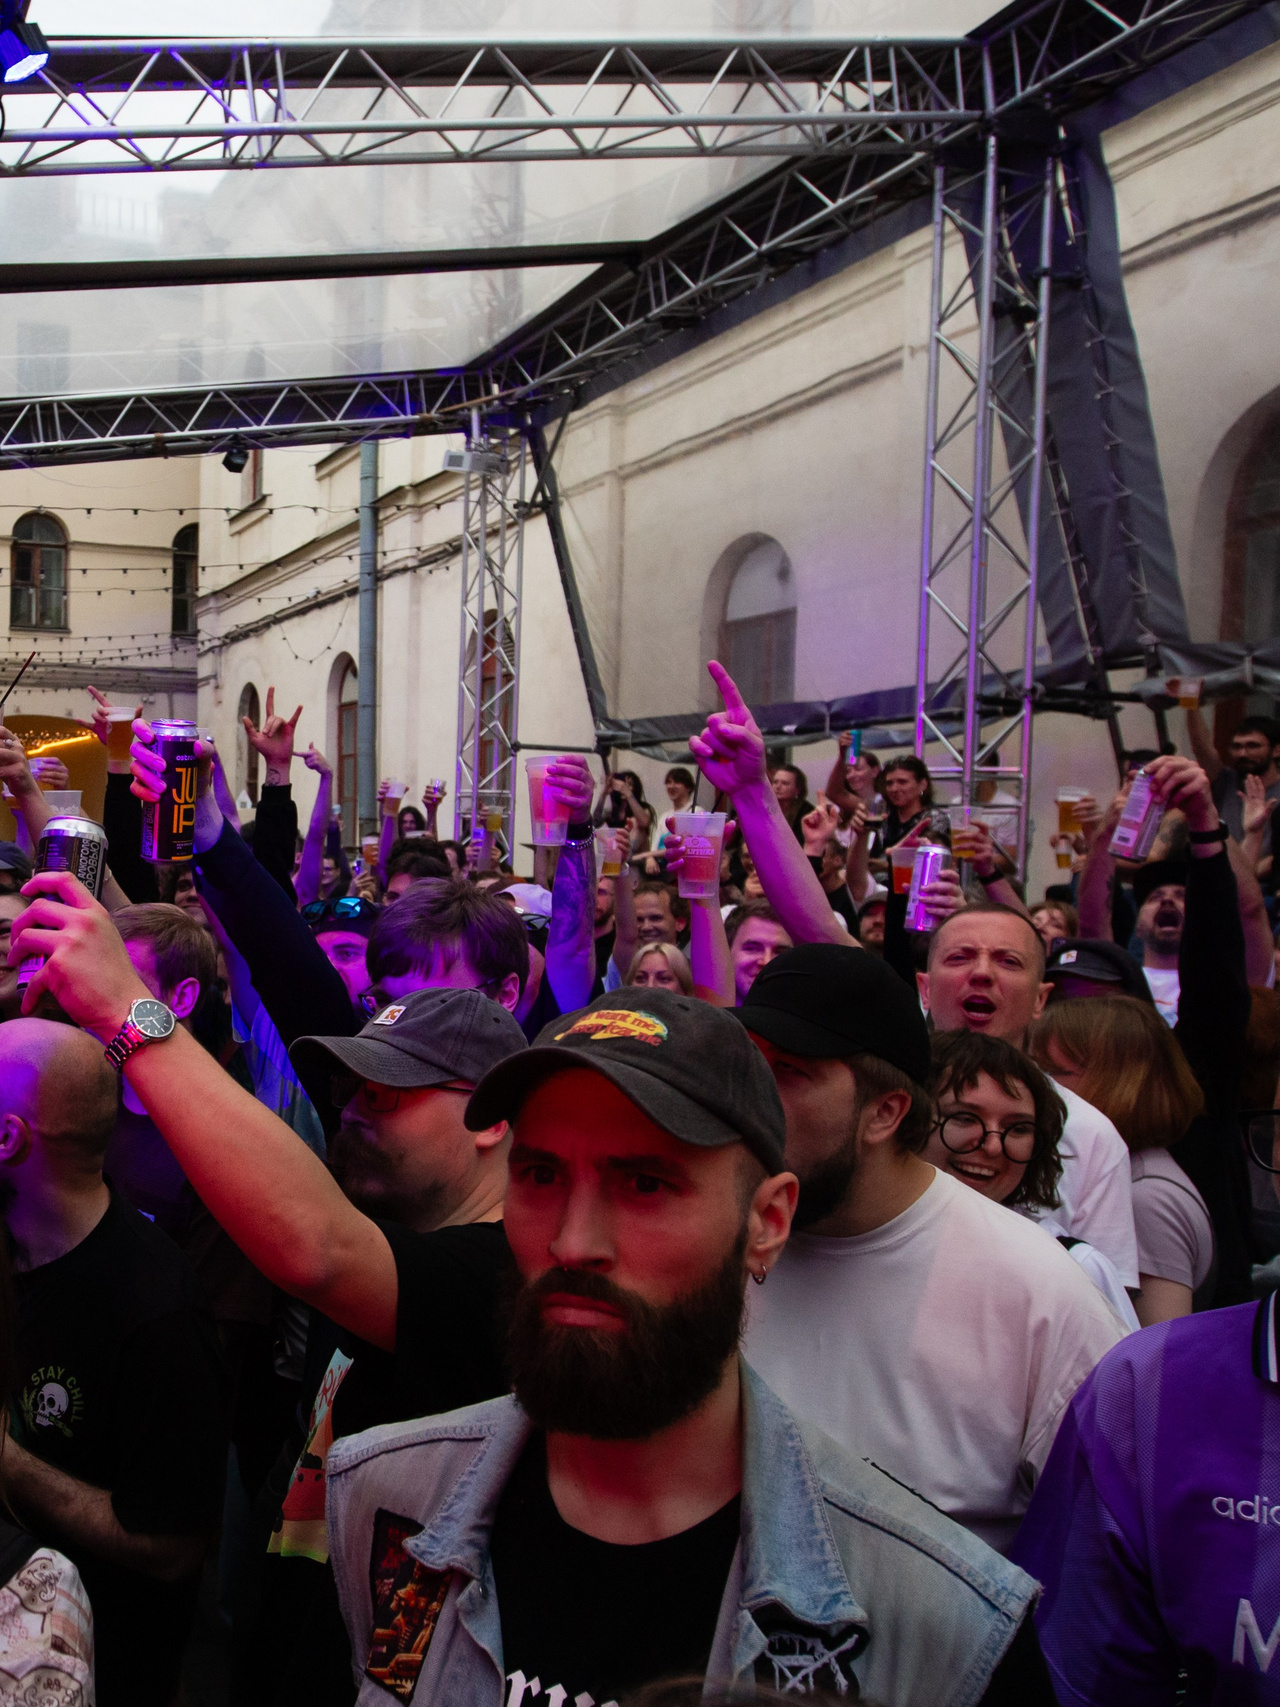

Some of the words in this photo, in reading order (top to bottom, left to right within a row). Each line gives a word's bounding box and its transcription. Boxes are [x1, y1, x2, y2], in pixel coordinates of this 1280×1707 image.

[78, 839, 90, 879] АЛКОГОЛЯ
[85, 842, 100, 894] ОРОВЬЮ
[31, 1366, 65, 1385] STAY
[66, 1376, 84, 1423] CHILL
